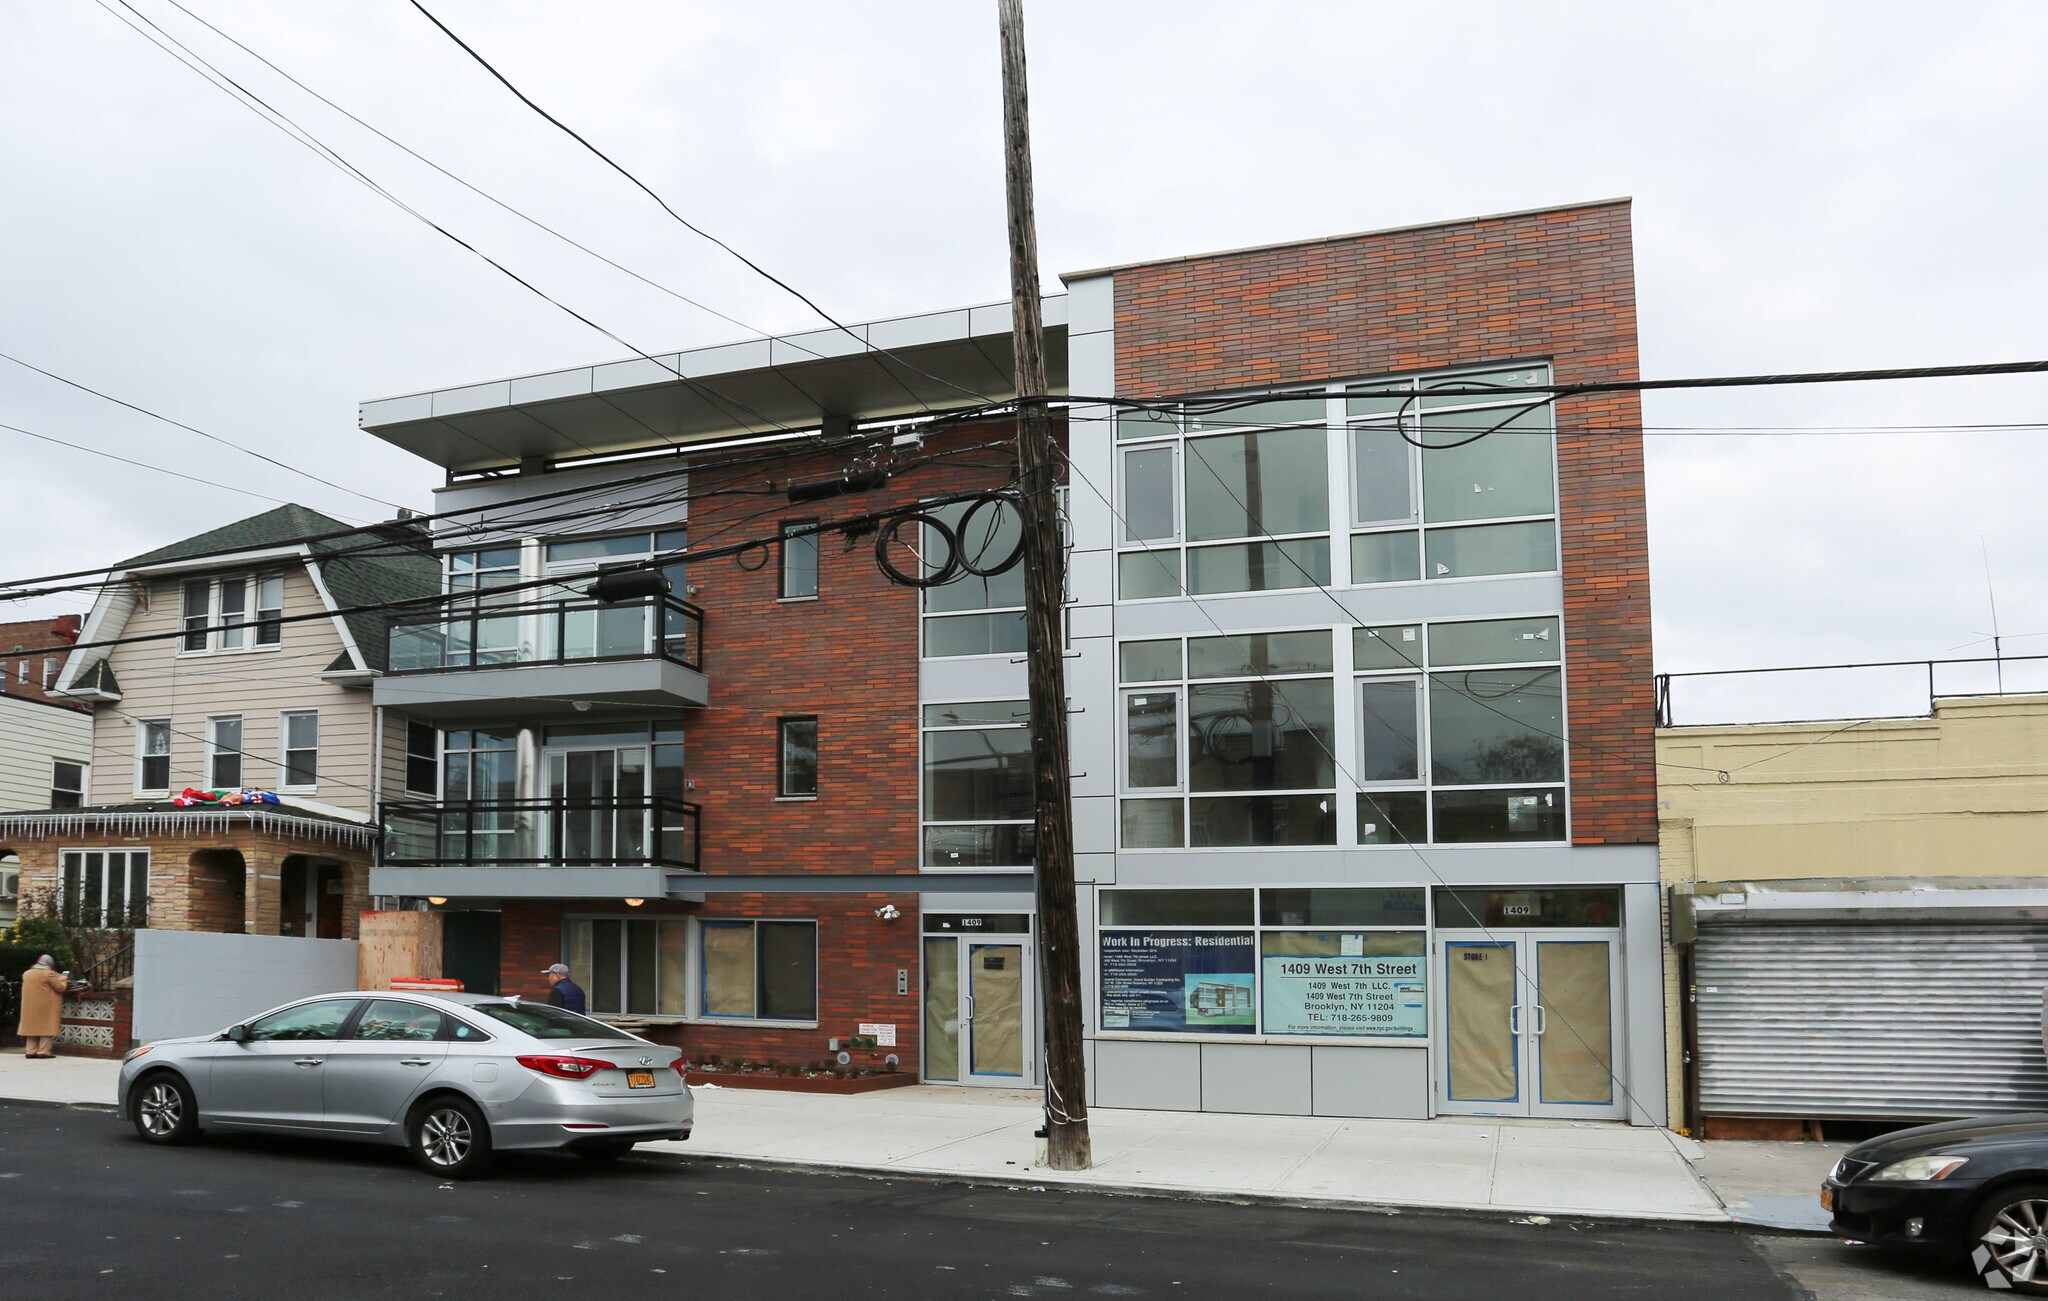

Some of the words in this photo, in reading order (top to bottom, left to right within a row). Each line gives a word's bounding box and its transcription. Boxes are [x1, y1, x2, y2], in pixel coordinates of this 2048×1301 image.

[1103, 937, 1127, 947] Work
[1131, 937, 1139, 947] In
[1144, 936, 1191, 948] Progress:
[1195, 936, 1253, 946] Residential
[1464, 953, 1482, 961] STORE
[1281, 964, 1310, 975] 1409
[1315, 964, 1347, 975] West
[1352, 964, 1371, 975] 7th
[1377, 964, 1416, 975] Street
[1309, 982, 1326, 990] 1409
[1331, 982, 1350, 990] West
[1355, 982, 1367, 990] 7th
[1372, 982, 1390, 990] LLC.
[1305, 1003, 1347, 1012] Brooklyn,
[1308, 1014, 1328, 1022] TEL:
[1331, 1014, 1393, 1022] 718-265-9809
